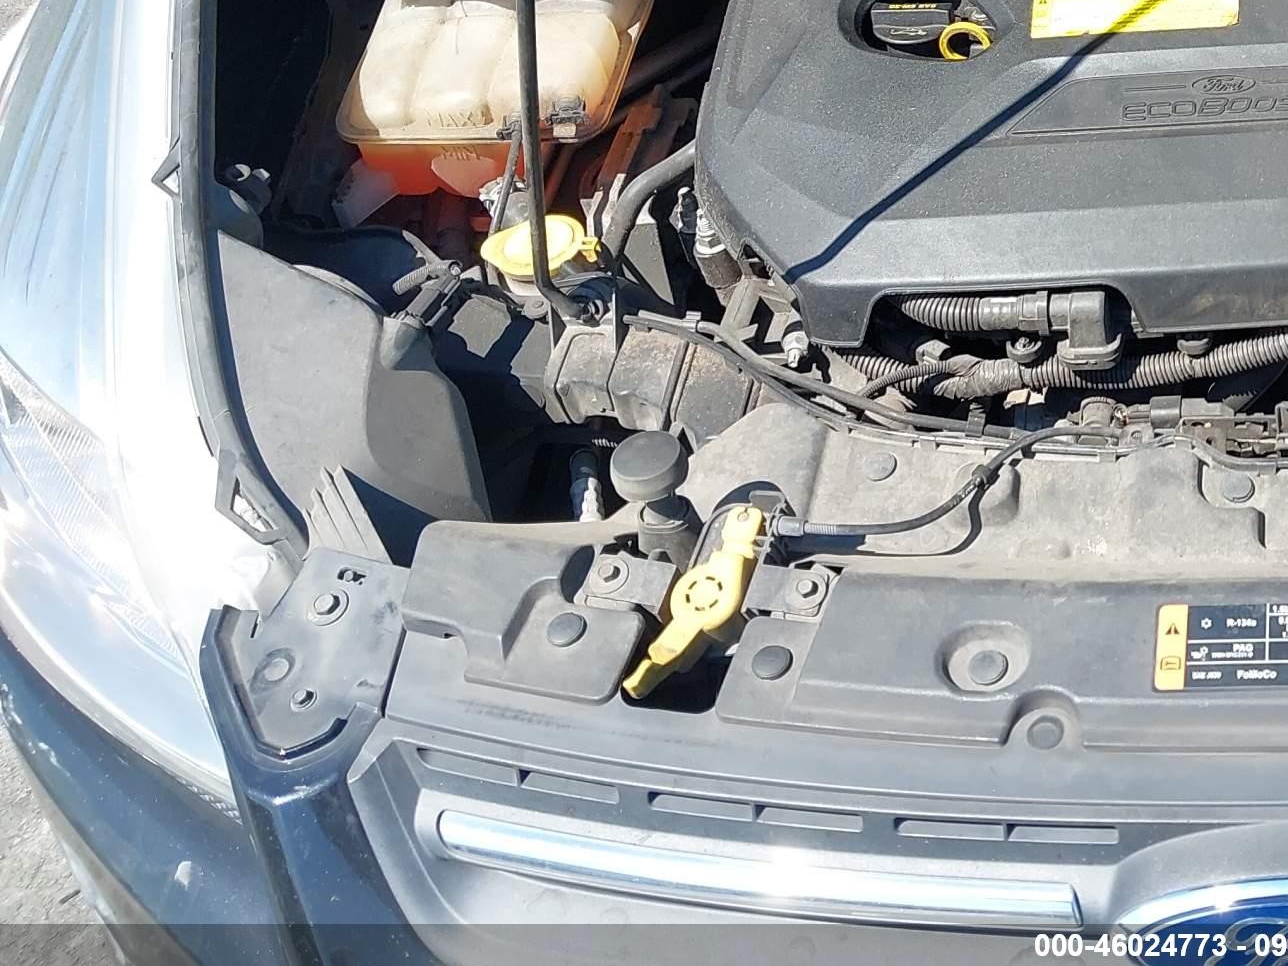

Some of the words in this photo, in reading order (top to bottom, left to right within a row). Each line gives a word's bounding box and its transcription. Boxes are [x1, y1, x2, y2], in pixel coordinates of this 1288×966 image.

[1203, 77, 1245, 93] Ford
[427, 111, 476, 127] MAX
[441, 145, 480, 160] MIN
[1226, 618, 1258, 628] R-134a
[1236, 669, 1278, 680] FoMoCo
